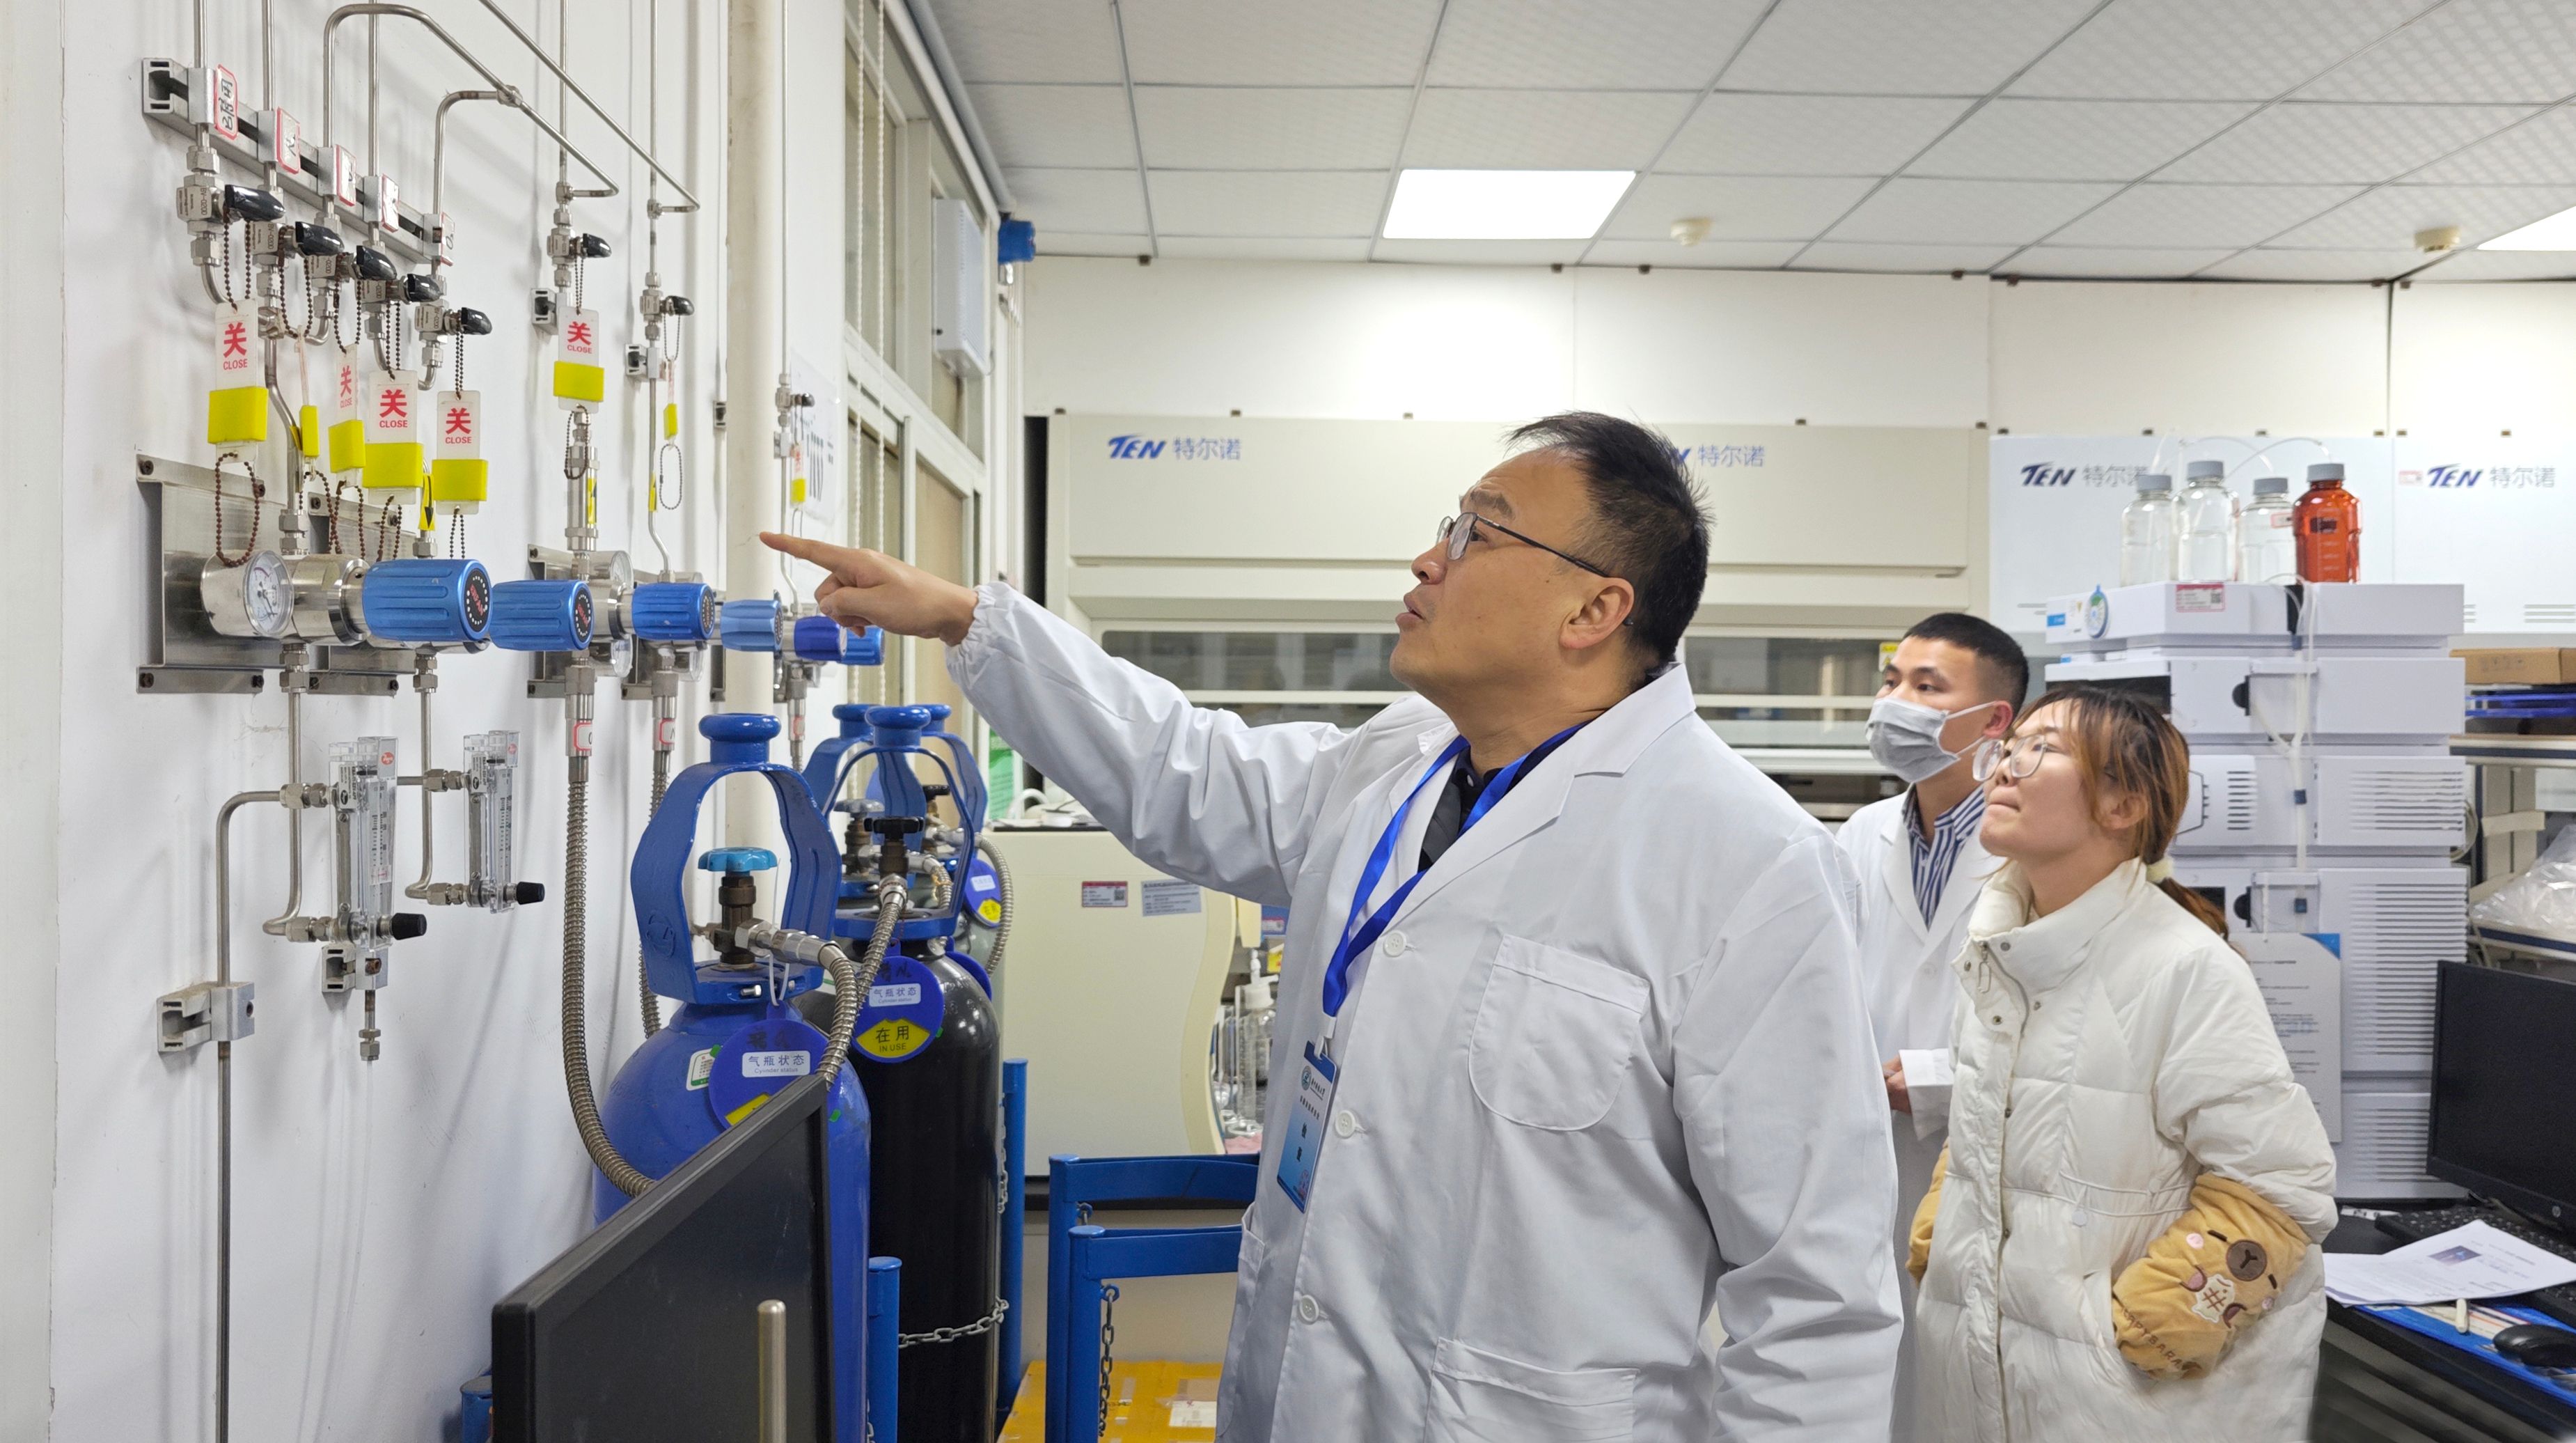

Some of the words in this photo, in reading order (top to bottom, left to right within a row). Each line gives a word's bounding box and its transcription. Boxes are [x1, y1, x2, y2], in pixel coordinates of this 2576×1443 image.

[223, 322, 247, 358] 关
[567, 321, 592, 345] 关
[567, 344, 592, 354] CLOSE
[223, 359, 248, 370] CLOSE
[340, 366, 352, 398] 关
[340, 398, 353, 408] CLOSE
[379, 389, 407, 418] 关
[379, 420, 408, 428] CLOSE
[446, 407, 472, 435] 关
[1108, 433, 1167, 460] TEN
[1173, 437, 1241, 460] 特尔诺
[1697, 444, 1765, 467] 特尔诺
[2021, 461, 2077, 486] TEN
[2427, 463, 2484, 488] TEN
[2490, 465, 2556, 488] 特尔诺
[874, 987, 917, 998] 气瓶状态
[876, 1025, 909, 1044] 在用
[748, 1054, 805, 1067] 气瓶状态
